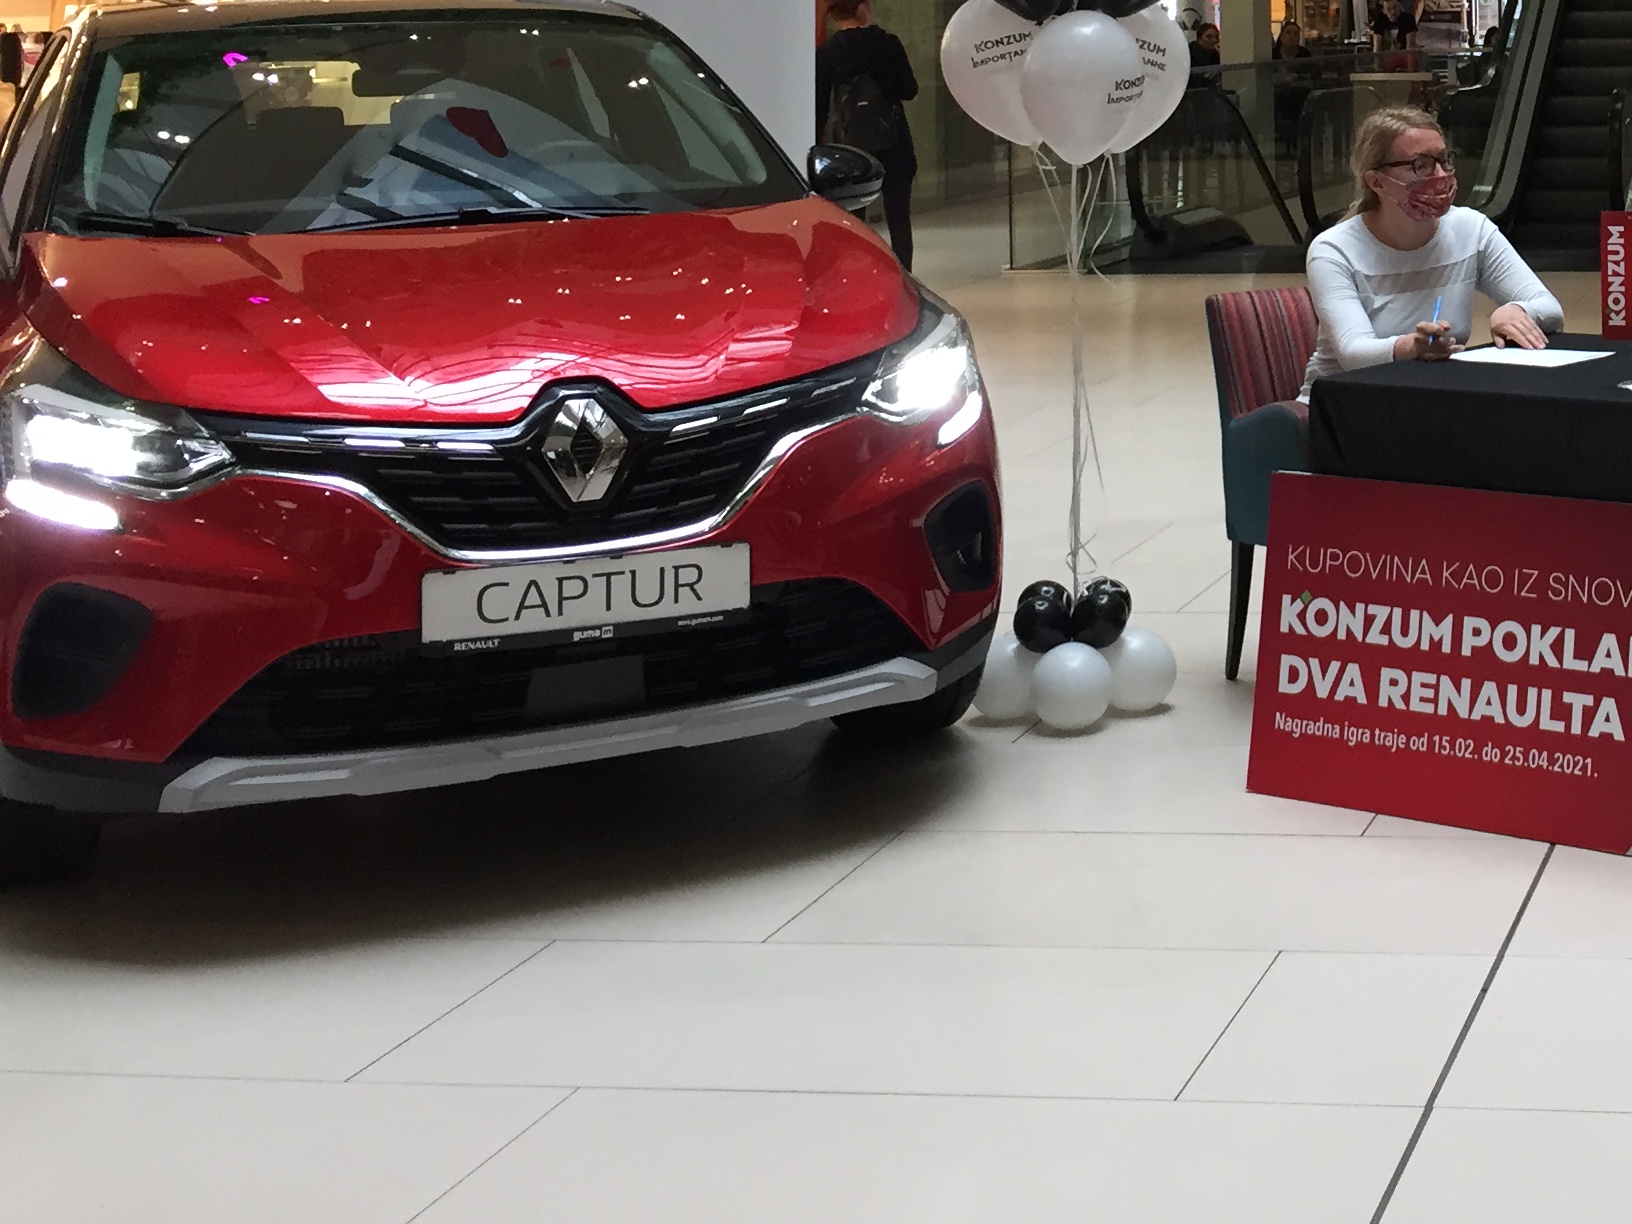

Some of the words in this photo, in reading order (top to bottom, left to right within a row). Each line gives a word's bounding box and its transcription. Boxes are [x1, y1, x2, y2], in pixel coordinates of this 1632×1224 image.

[974, 30, 1034, 54] KONZUM
[1606, 225, 1627, 327] KONZUM
[475, 562, 704, 625] CAPTUR
[1287, 543, 1433, 587] KUPOVINA
[1441, 560, 1505, 594] KAO
[1513, 567, 1540, 598] IZ
[453, 638, 501, 652] RENAULT
[1279, 591, 1454, 654] KONZUM
[1277, 652, 1368, 705] DVA
[1377, 665, 1626, 742] RENAULTA
[1274, 711, 1341, 739] Nagradna
[1343, 720, 1371, 747] igra
[1374, 727, 1407, 753] traje
[1409, 731, 1428, 752] od
[1432, 734, 1479, 760] 15.02.
[1481, 740, 1501, 763] do
[1503, 744, 1599, 778] 25.04.2021.
